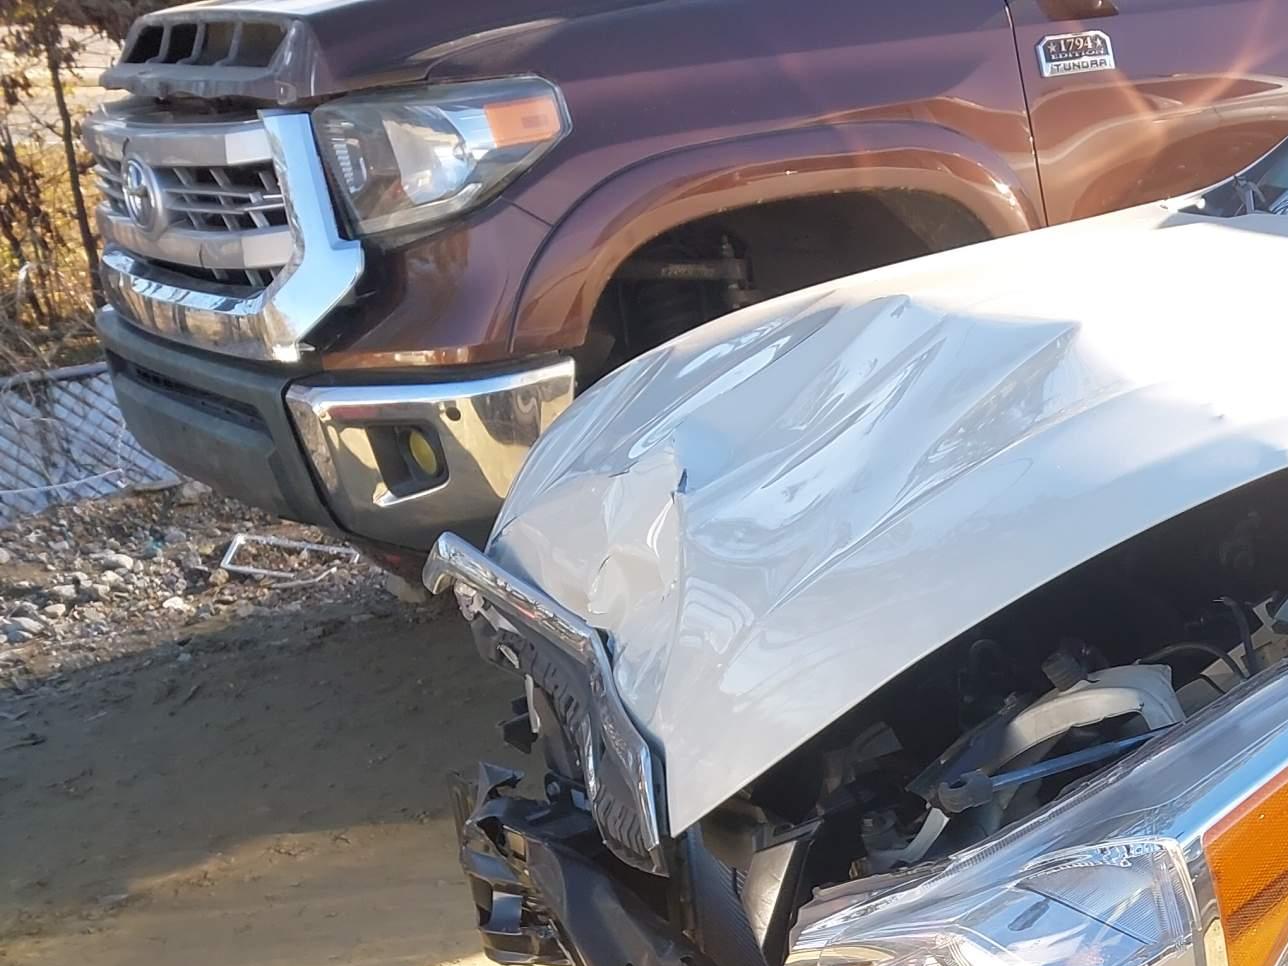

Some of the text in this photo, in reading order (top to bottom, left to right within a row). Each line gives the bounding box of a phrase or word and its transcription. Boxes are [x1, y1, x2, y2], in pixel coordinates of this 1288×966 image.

[1060, 36, 1093, 52] 1794
[1050, 48, 1105, 60] EDITION
[1053, 58, 1108, 72] TUNDRA
